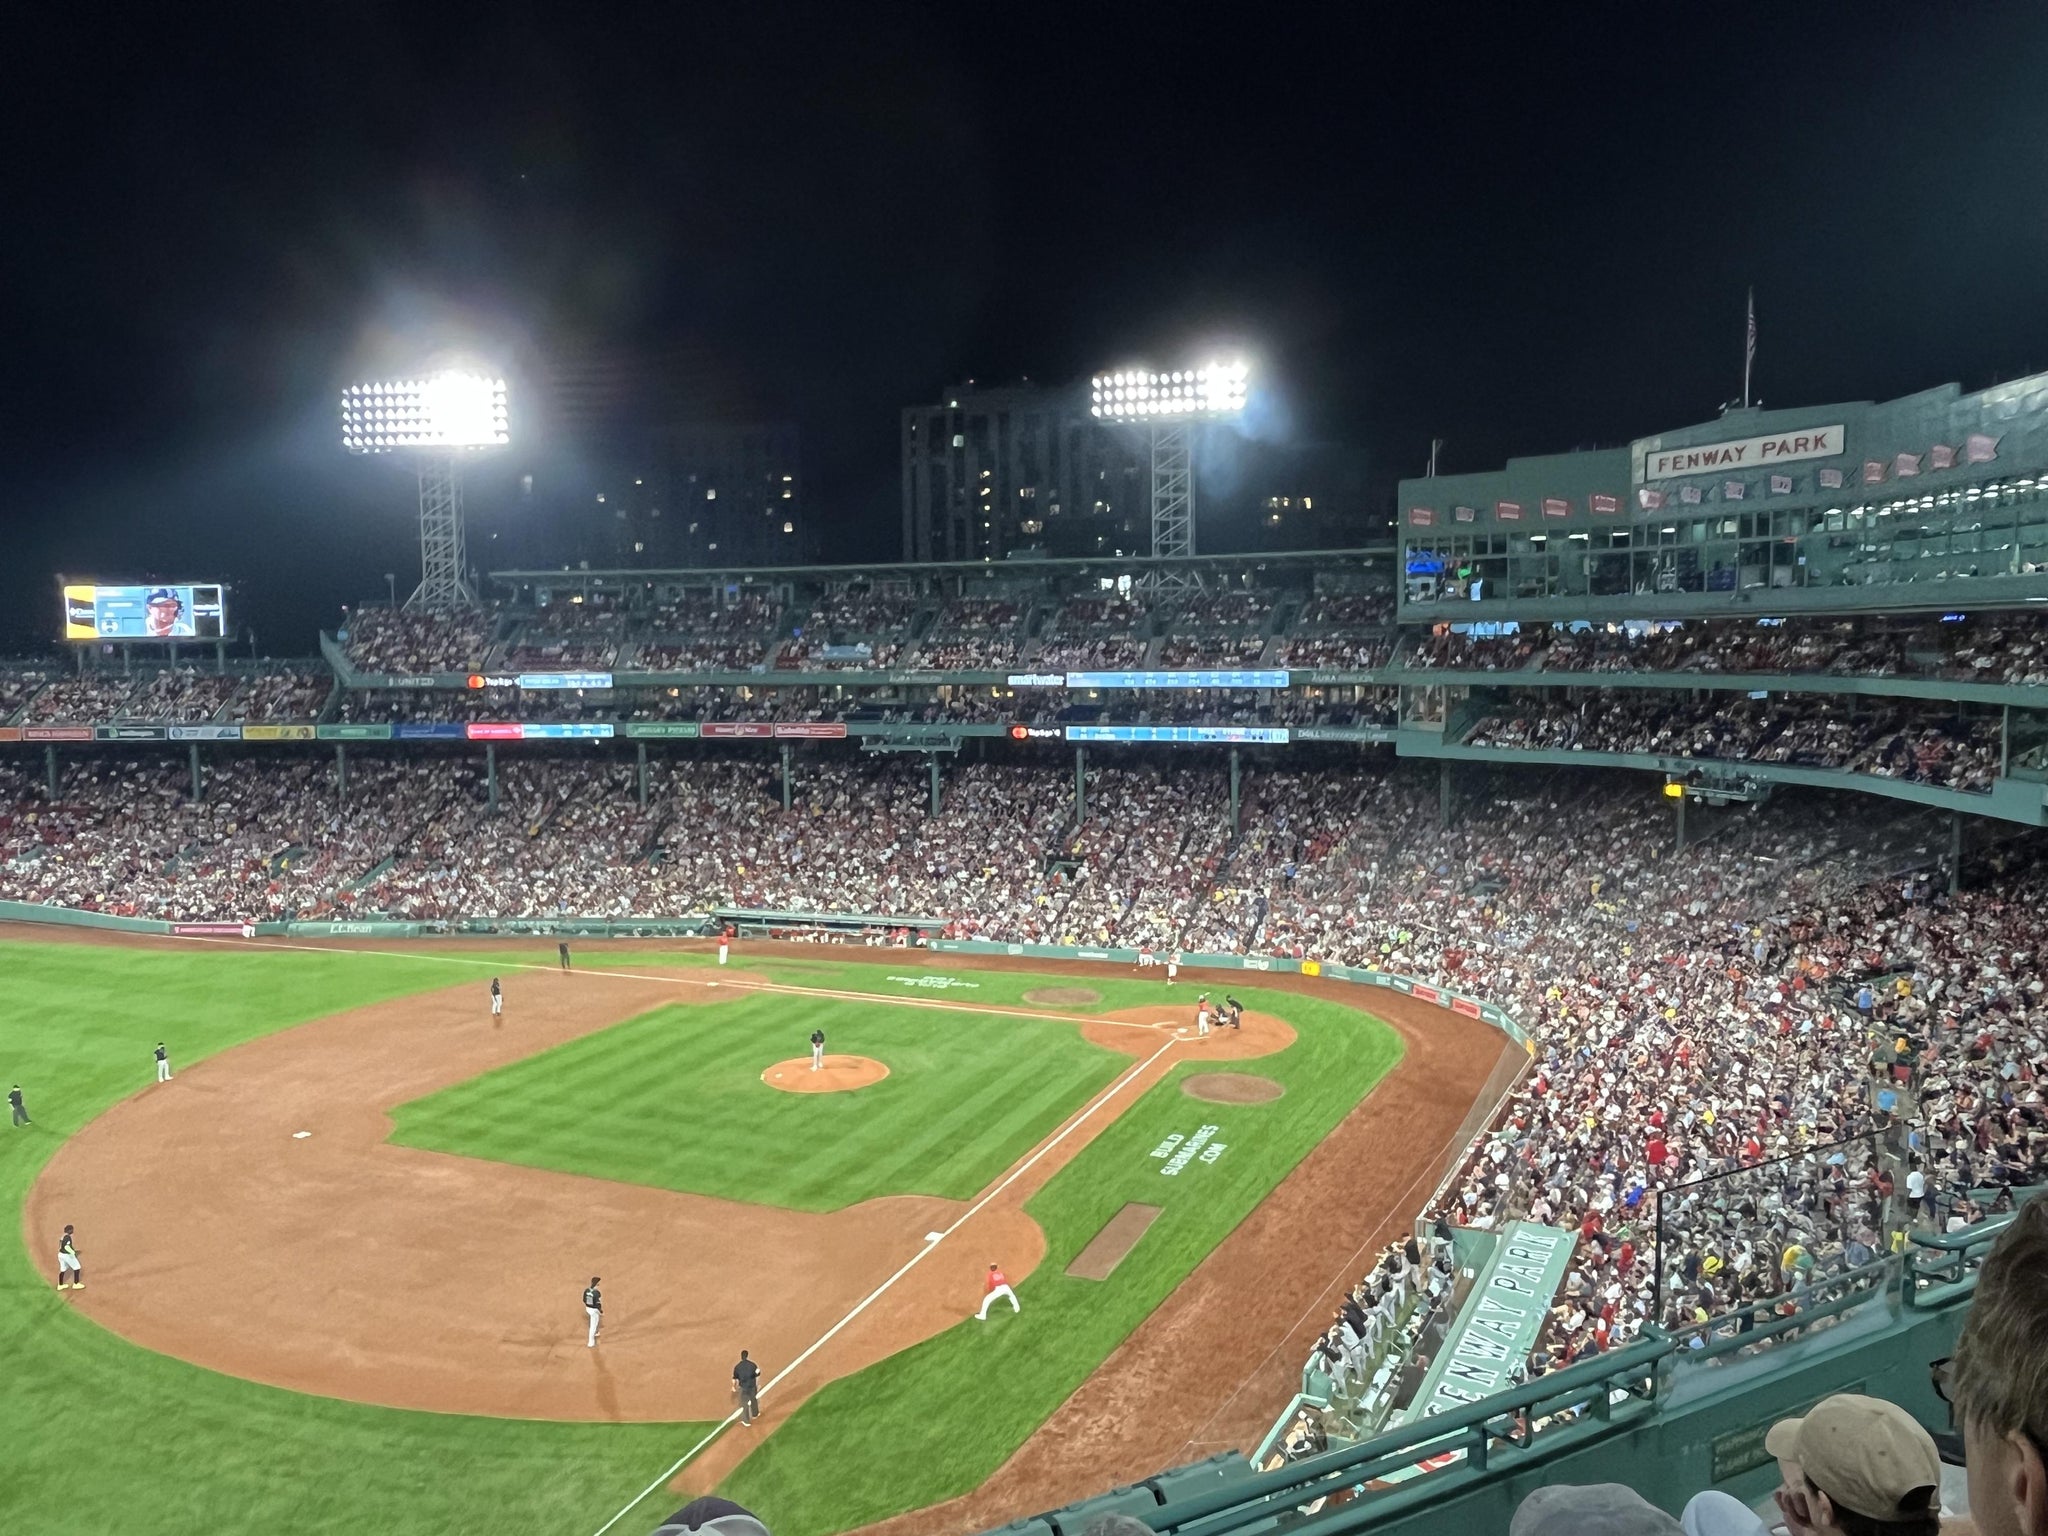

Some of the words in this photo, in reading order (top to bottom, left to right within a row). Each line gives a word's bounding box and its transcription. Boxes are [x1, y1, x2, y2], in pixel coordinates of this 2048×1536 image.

[1658, 445, 1748, 473] FENWAY
[1761, 433, 1828, 459] PARK
[398, 677, 435, 687] UNITED
[1149, 1133, 1185, 1159] BUILD
[1489, 1229, 1559, 1298] PARK
